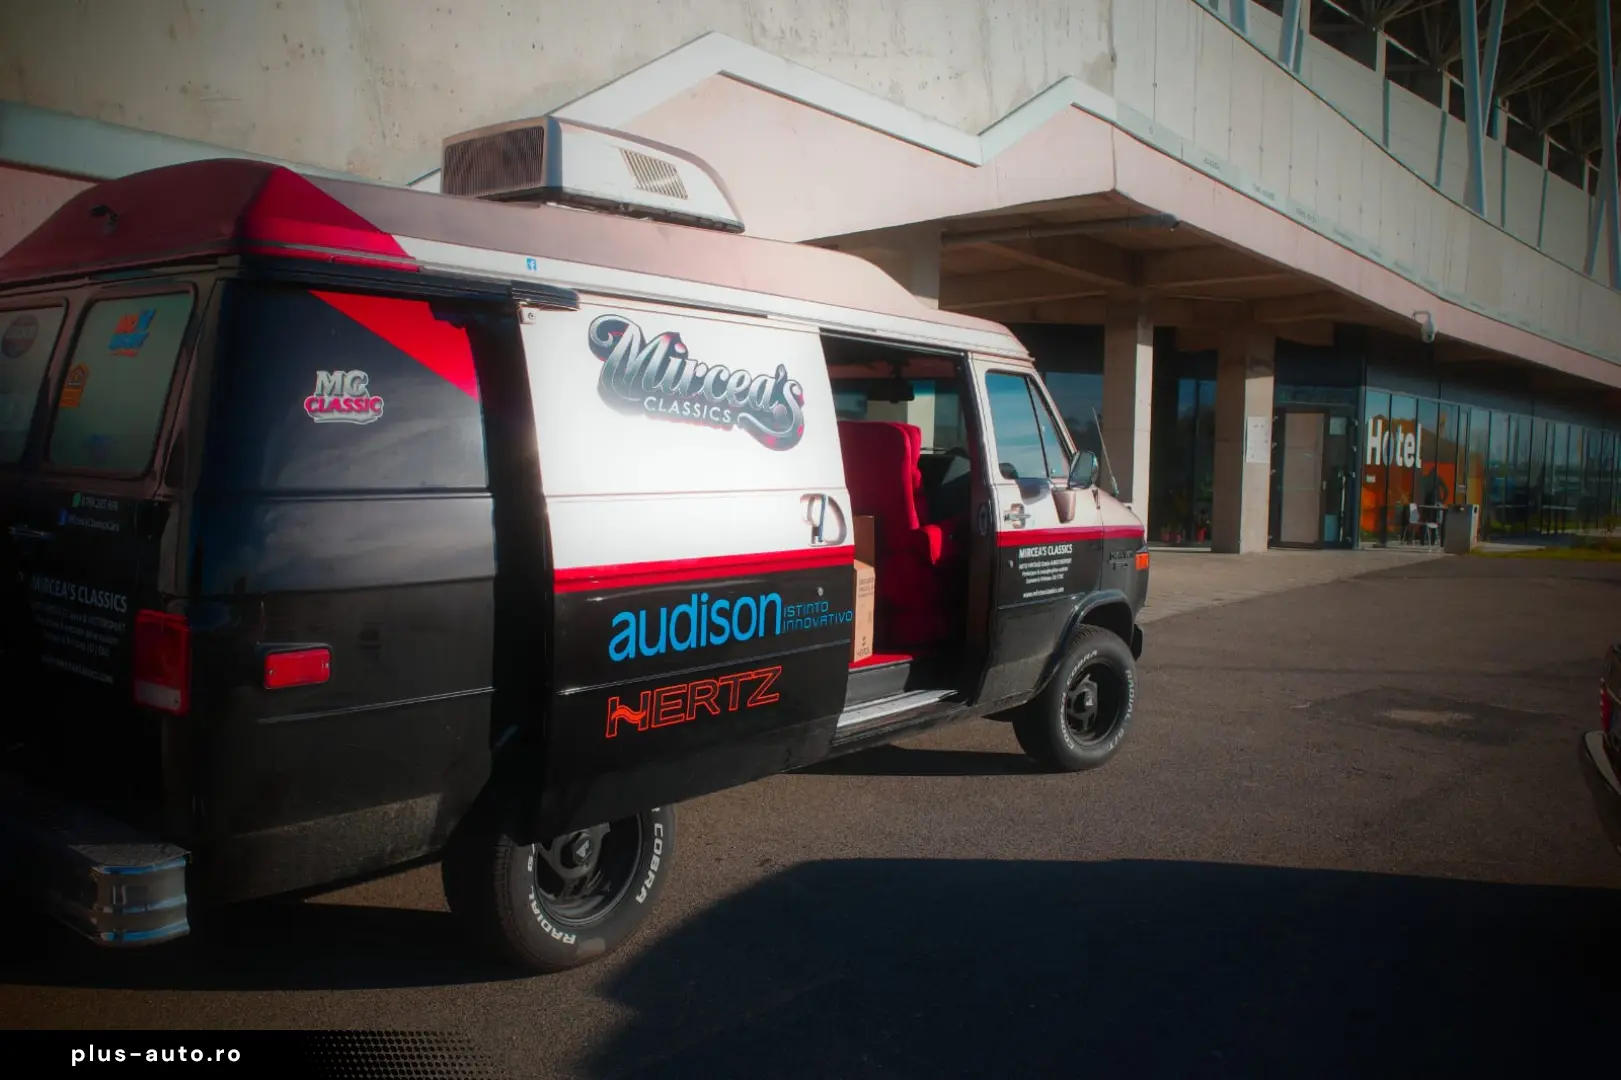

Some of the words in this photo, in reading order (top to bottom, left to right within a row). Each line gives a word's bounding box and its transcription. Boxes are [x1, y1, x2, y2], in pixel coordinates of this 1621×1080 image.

[304, 396, 383, 413] CLASSIC
[588, 313, 804, 450] Mircea's
[643, 396, 732, 424] CLASSICS
[1366, 418, 1422, 468] Hotel
[1019, 546, 1047, 559] MIRCEA'S
[1048, 543, 1073, 555] CLASSICS
[78, 583, 128, 614] CLASSICS
[608, 591, 782, 662] audison
[604, 665, 783, 739] HERTZ
[635, 823, 664, 904] COBRA
[528, 885, 577, 945] RADIAL
